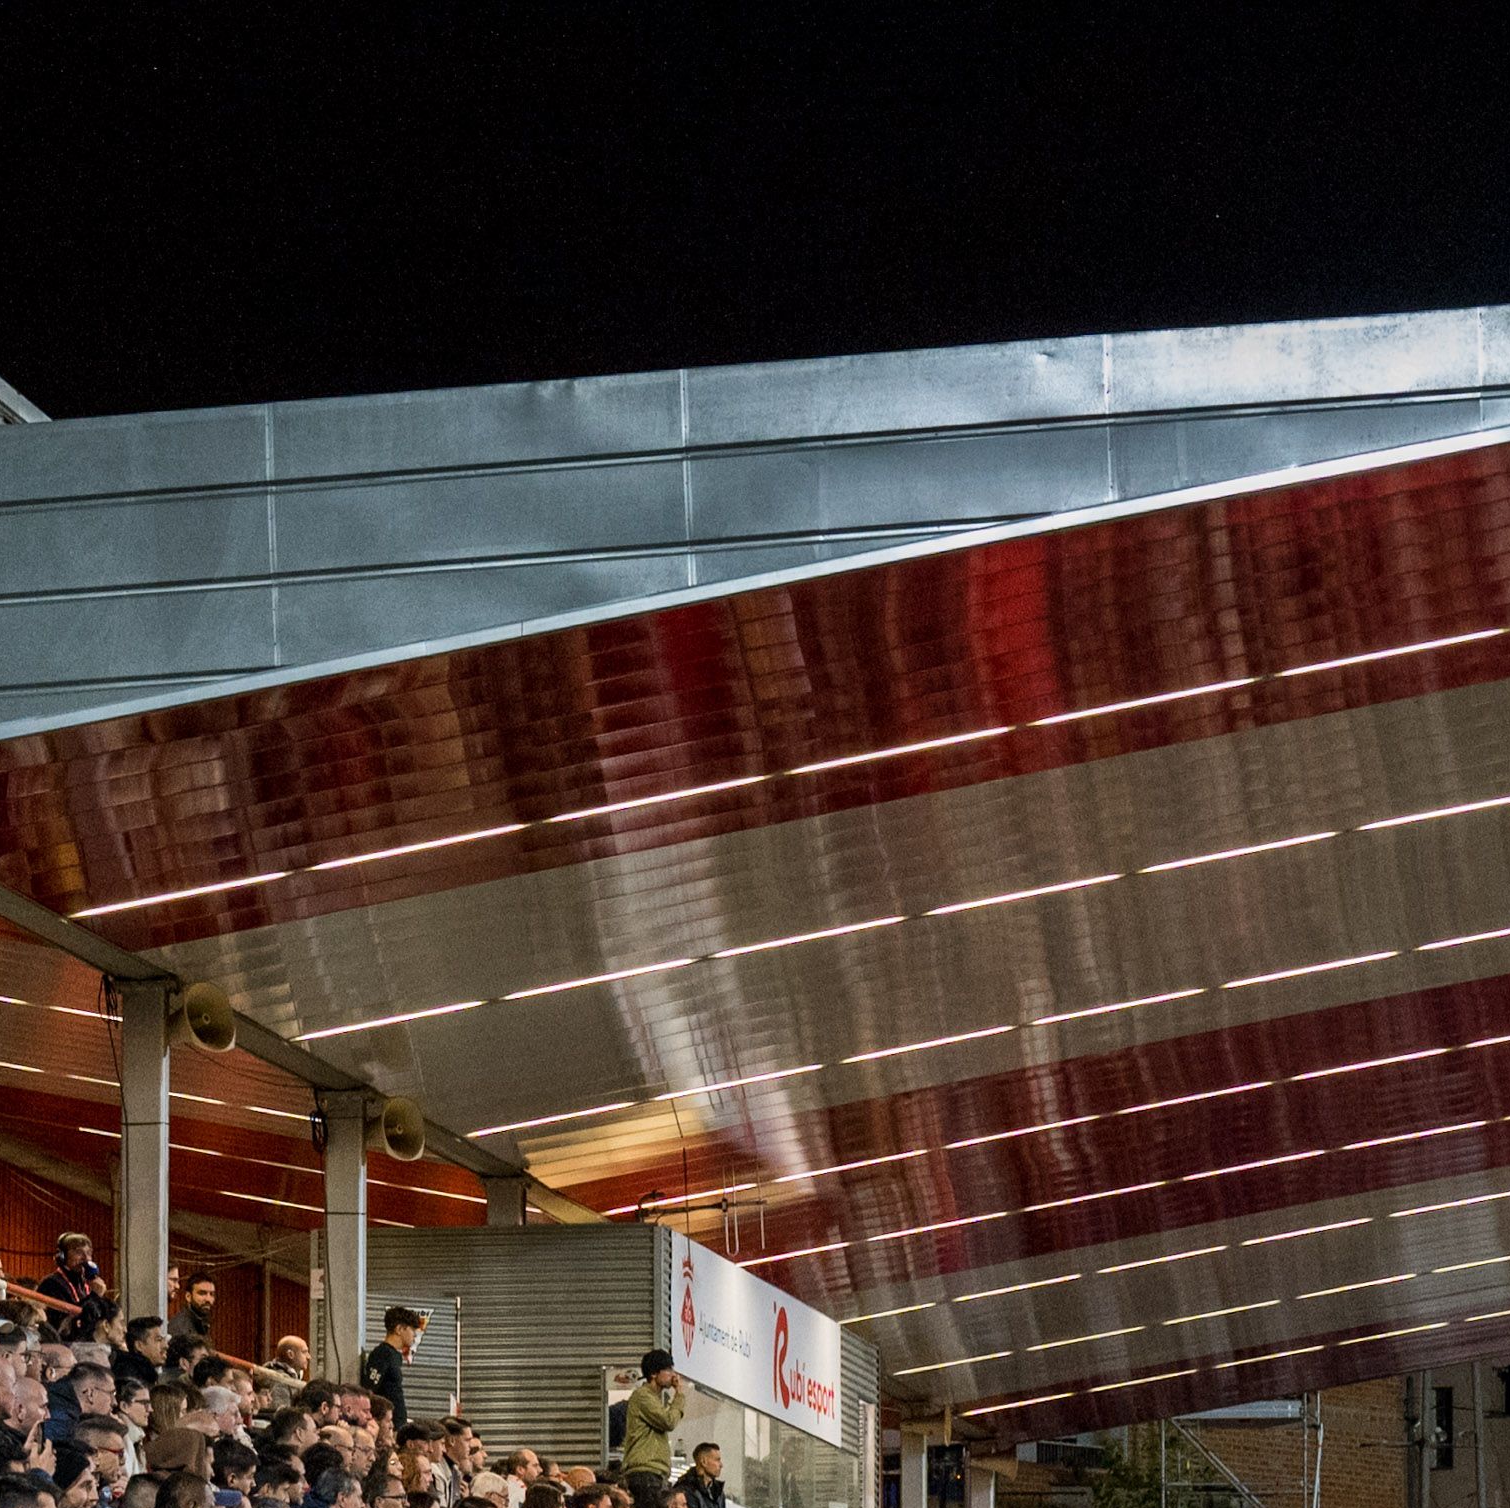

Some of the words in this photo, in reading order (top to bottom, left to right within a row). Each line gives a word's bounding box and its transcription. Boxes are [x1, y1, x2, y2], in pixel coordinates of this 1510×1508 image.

[699, 1310, 730, 1350] Ajuntament
[730, 1325, 738, 1353] de
[806, 1377, 836, 1425] esport
